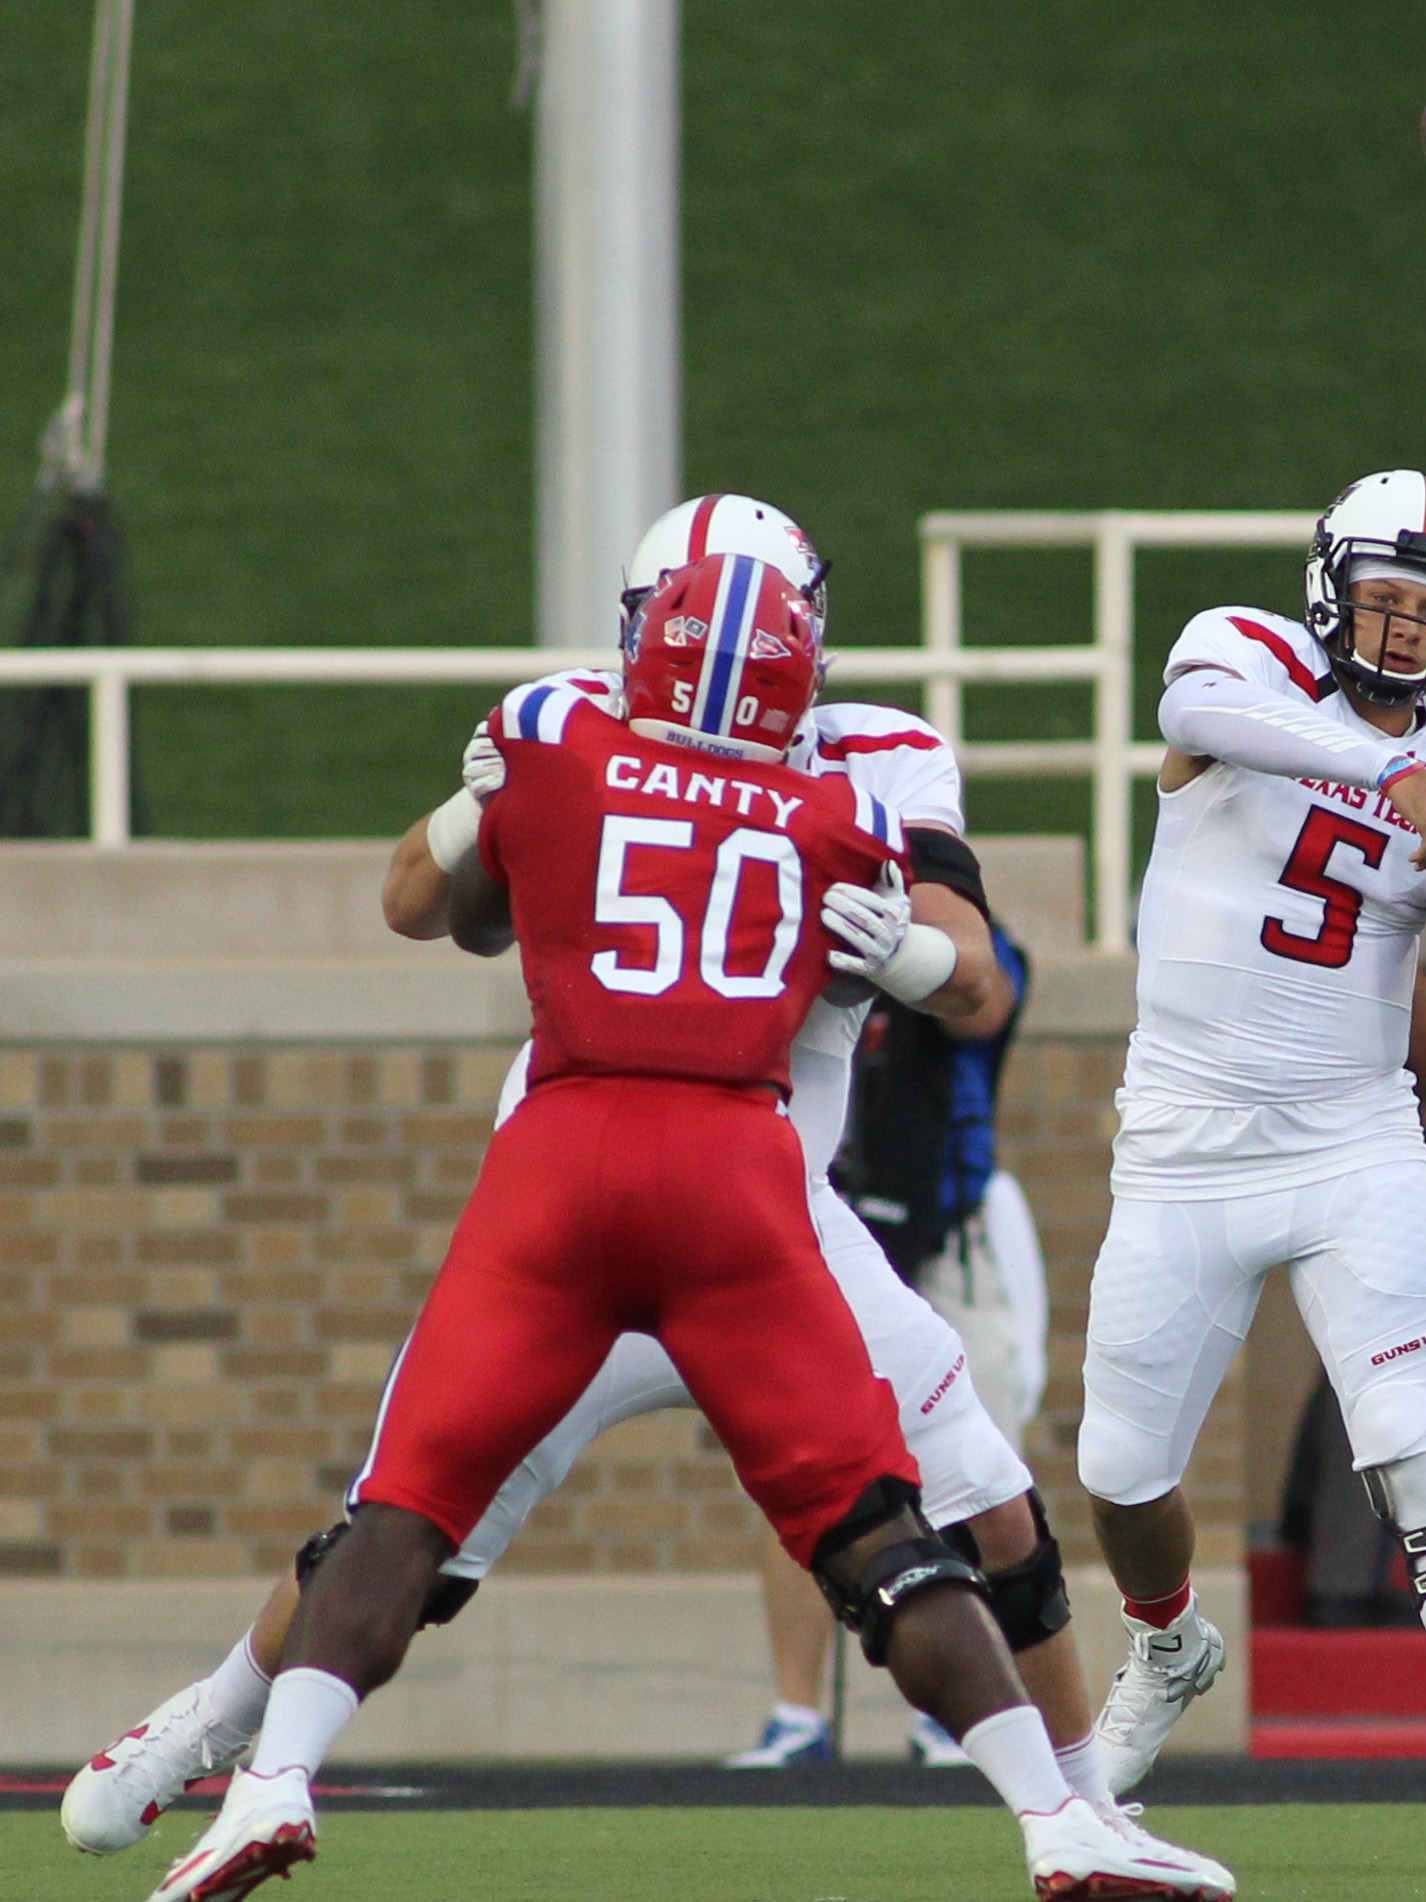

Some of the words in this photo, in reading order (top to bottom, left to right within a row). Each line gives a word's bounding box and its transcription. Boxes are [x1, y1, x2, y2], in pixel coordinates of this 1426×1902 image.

[666, 730, 744, 760] BULLDOGS
[605, 754, 804, 828] CANTY
[590, 813, 803, 999] 50
[1260, 803, 1391, 969] 5
[1370, 1338, 1421, 1366] GUNS
[920, 1369, 956, 1415] GUNS
